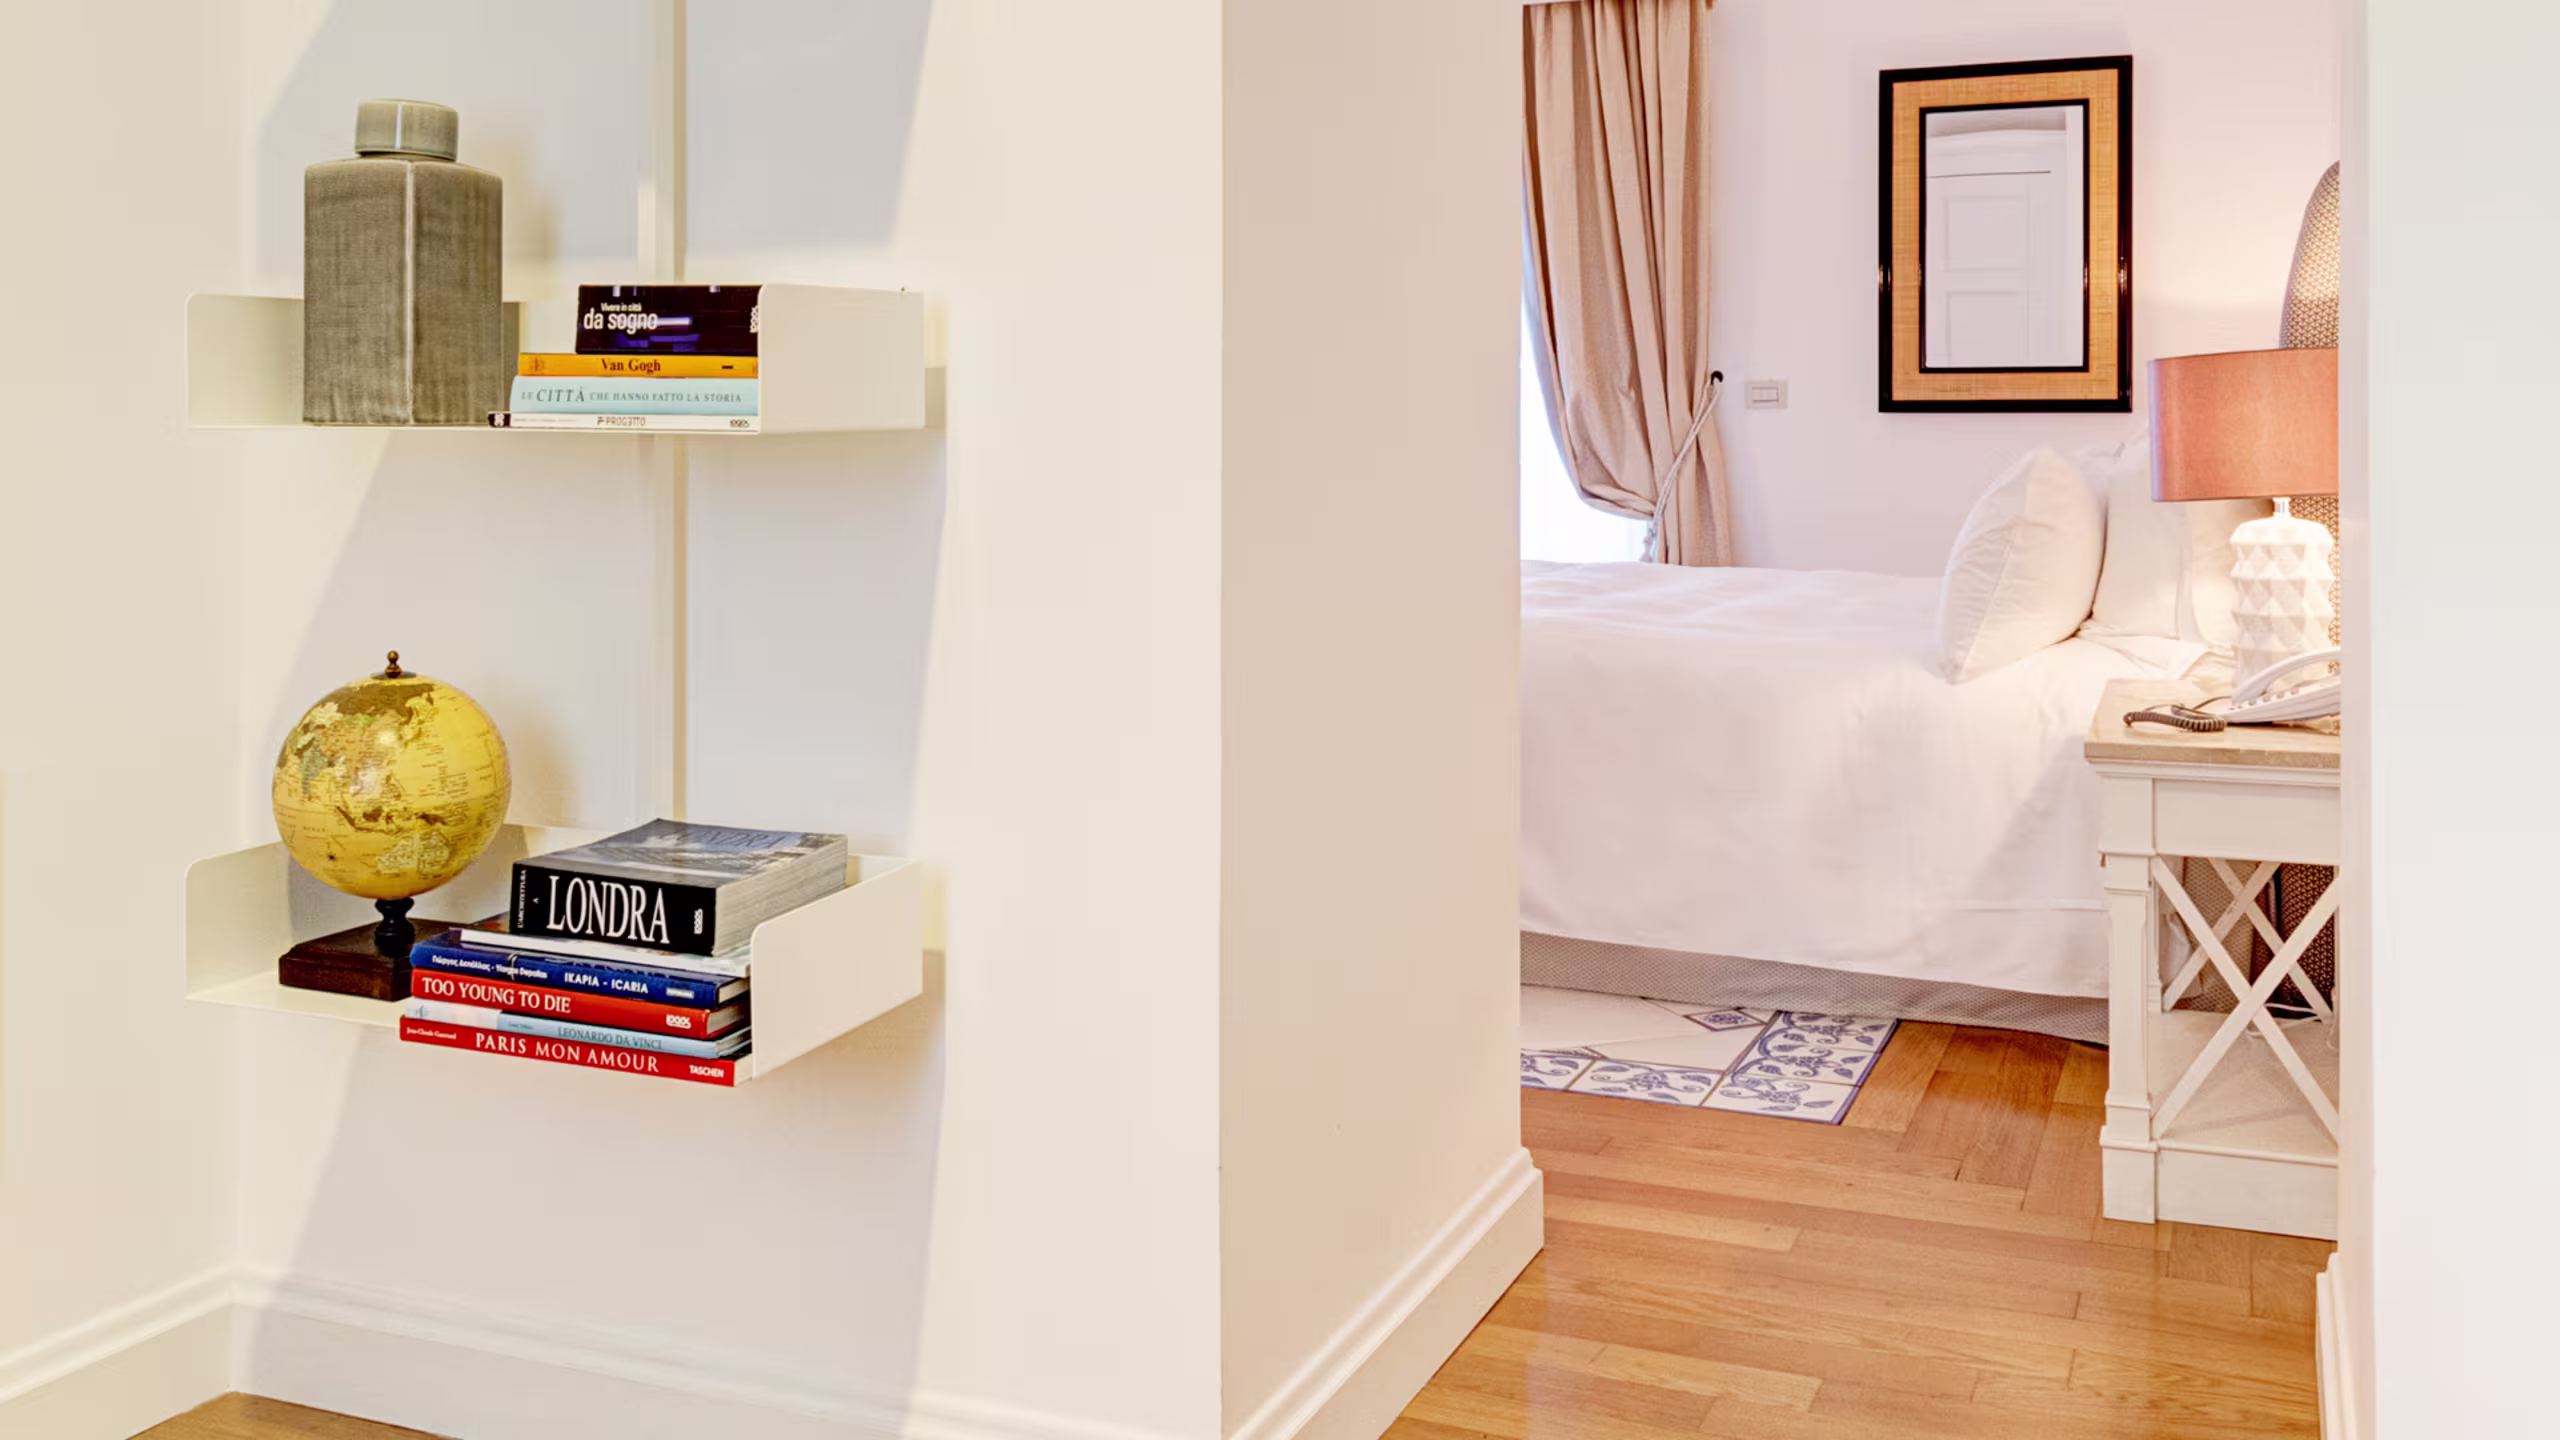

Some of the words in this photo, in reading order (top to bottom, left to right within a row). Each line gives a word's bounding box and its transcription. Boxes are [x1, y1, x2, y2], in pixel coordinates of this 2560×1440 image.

[583, 307, 604, 330] da
[607, 313, 658, 335] sogno
[600, 358, 624, 372] Van
[628, 358, 662, 374] Gogh
[536, 386, 586, 403] CITTÀ
[590, 391, 608, 401] CHE
[612, 392, 649, 401] HANNO
[652, 392, 684, 402] FATTO
[686, 393, 700, 402] LA
[704, 393, 743, 403] STORIA
[546, 875, 670, 944] LONDRA
[421, 977, 455, 996] TOO
[458, 982, 515, 1005] YOUNG
[518, 991, 541, 1009] TO
[544, 995, 572, 1013] DIE
[611, 978, 649, 994] ICARIA
[557, 1026, 613, 1044] LEONARDO
[615, 1033, 630, 1046] DA
[632, 1036, 663, 1049] VINCI
[475, 1032, 527, 1054] PARIS
[535, 1041, 580, 1061] MON
[587, 1048, 659, 1073] AMOUR
[689, 1065, 724, 1078] TASCHEN
